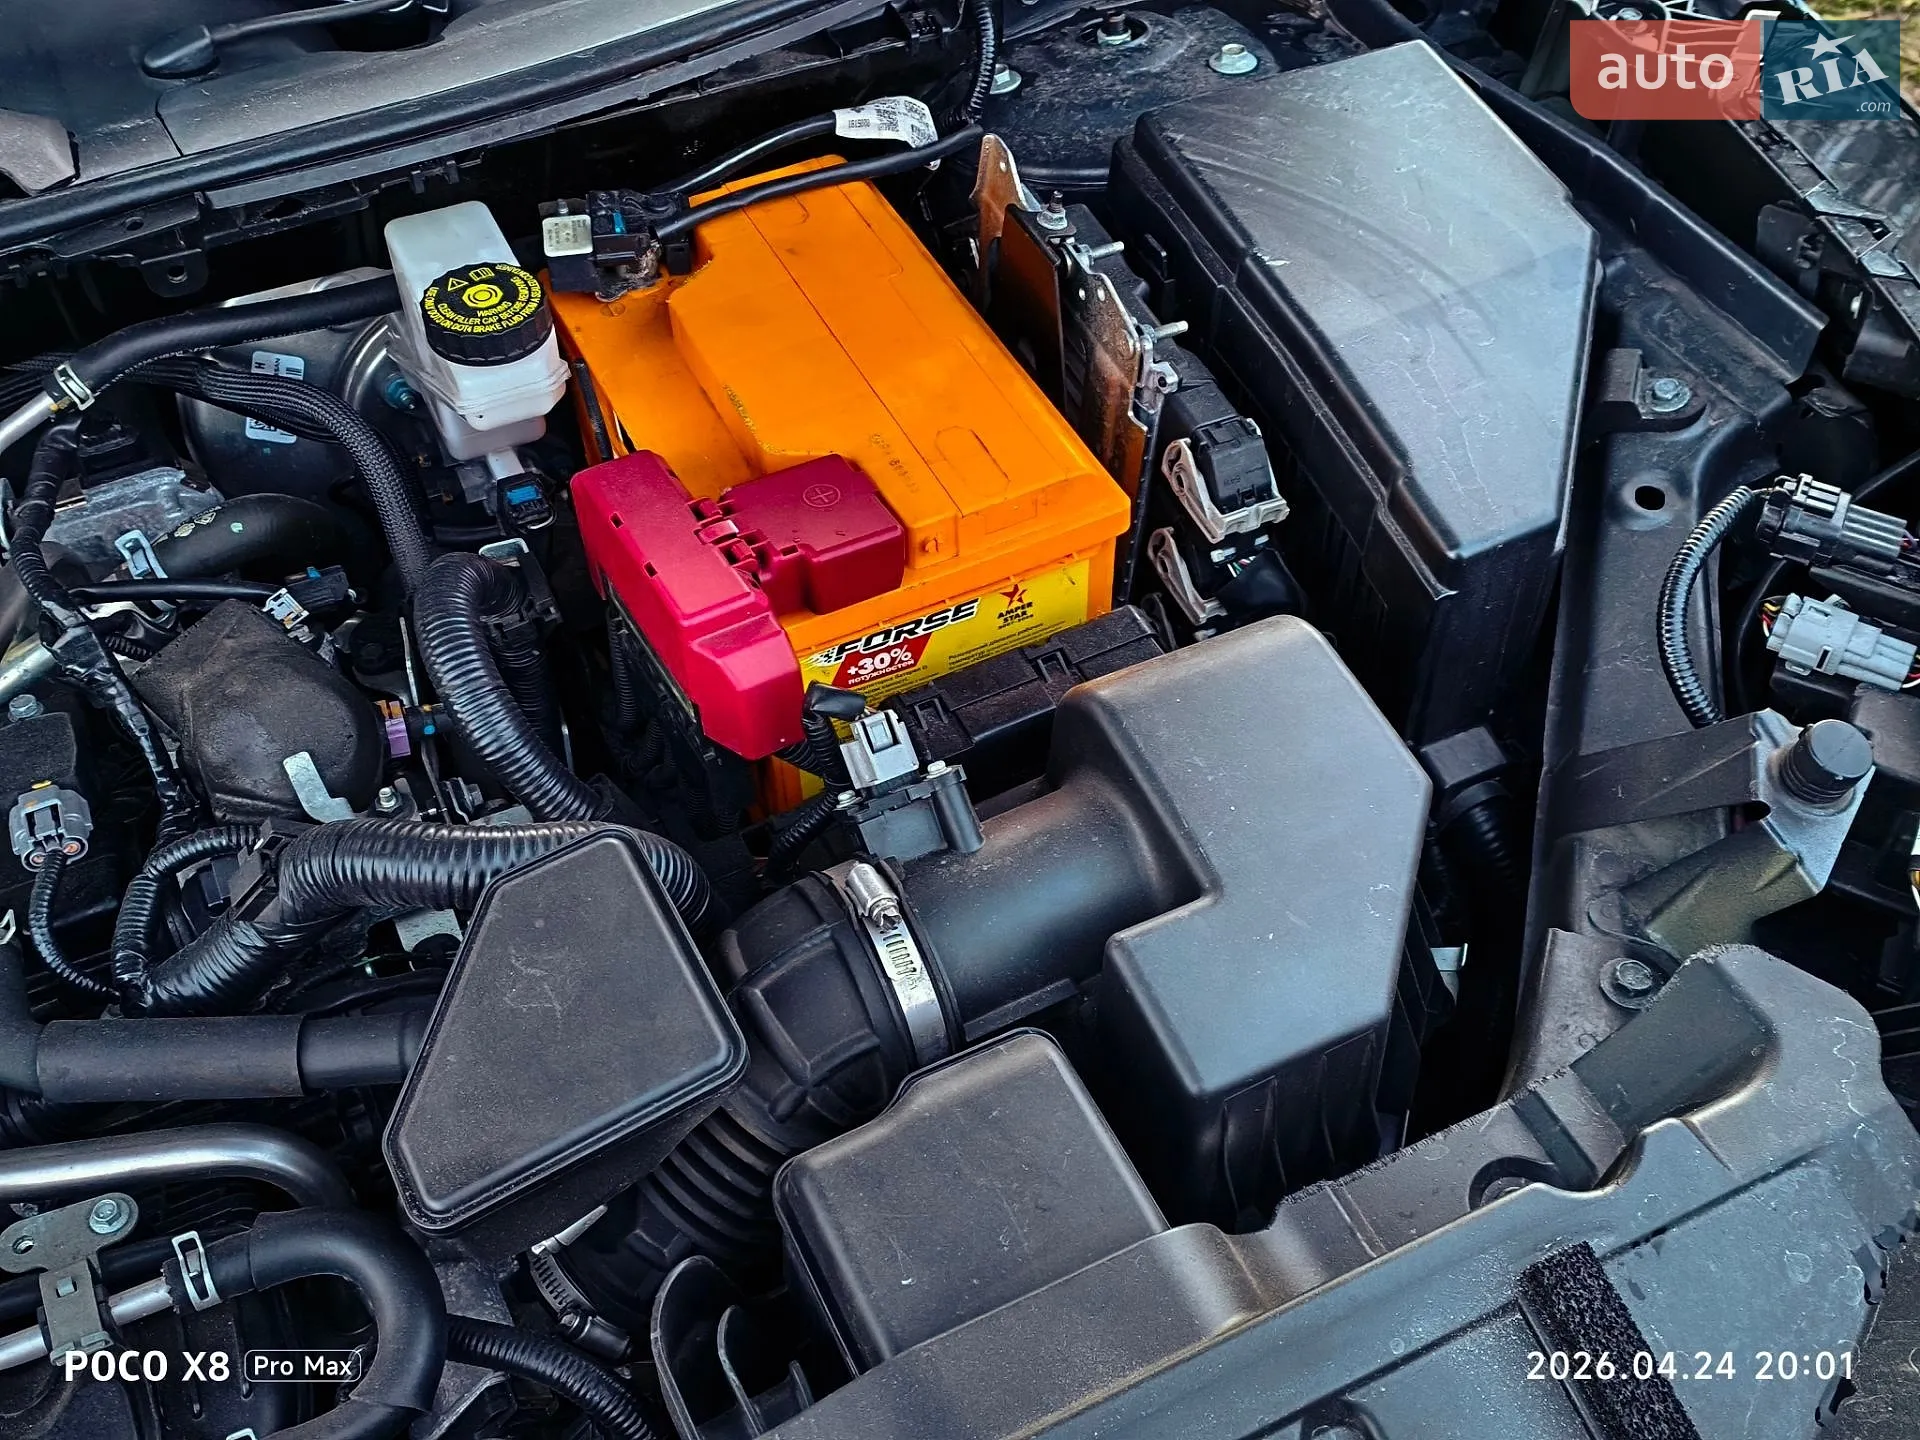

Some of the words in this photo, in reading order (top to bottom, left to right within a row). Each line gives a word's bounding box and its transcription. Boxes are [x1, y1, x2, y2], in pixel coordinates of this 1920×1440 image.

[438, 303, 457, 319] CLEAN
[454, 315, 481, 325] FILLER
[482, 315, 499, 325] CAP
[499, 301, 526, 320] BEFORE
[472, 322, 503, 333] BRAKE
[501, 314, 524, 328] FLUID
[520, 302, 539, 318] FROM
[477, 301, 512, 317] WARNING
[997, 601, 1033, 619] AMPER
[1003, 610, 1028, 624] STAR
[834, 596, 982, 664] FORSE
[847, 644, 912, 676] +30%
